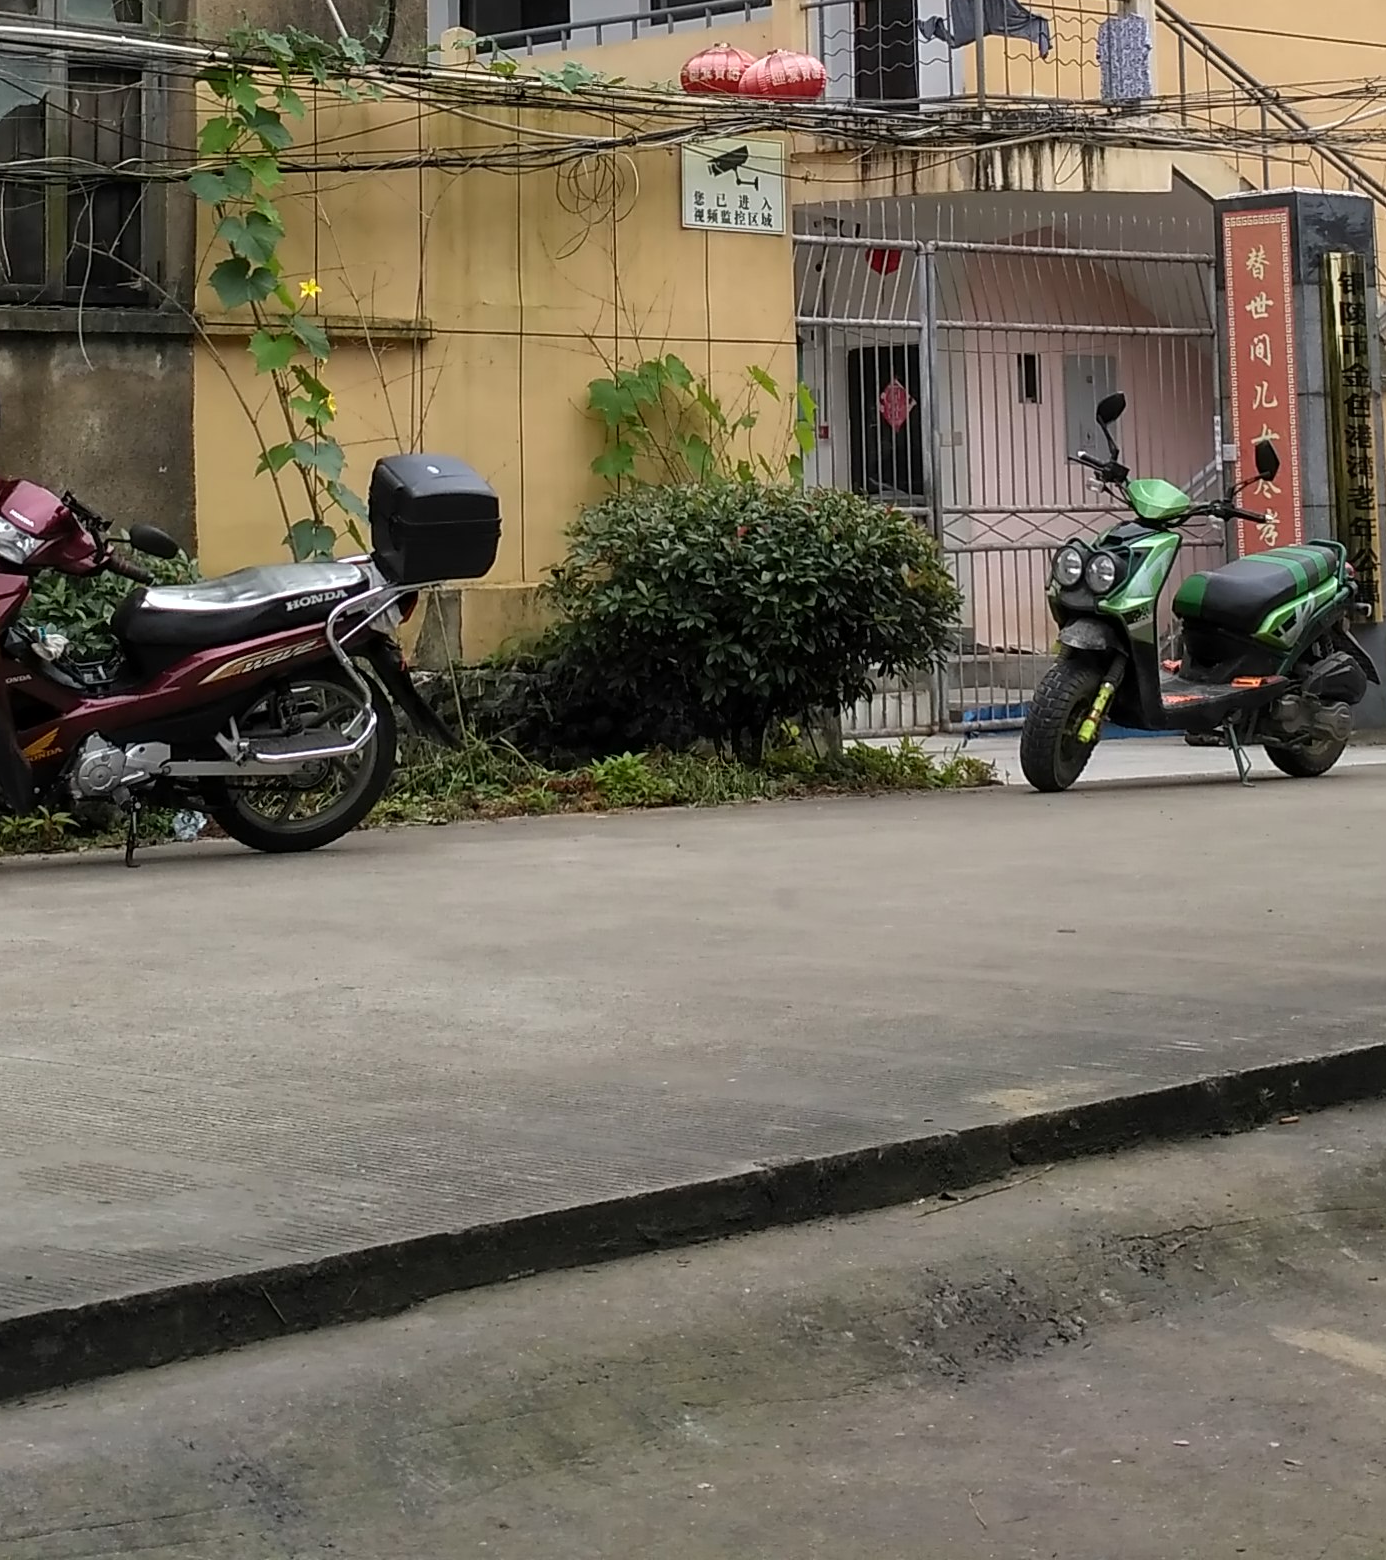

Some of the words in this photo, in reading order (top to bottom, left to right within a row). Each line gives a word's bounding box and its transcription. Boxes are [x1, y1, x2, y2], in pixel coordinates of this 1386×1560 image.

[693, 190, 773, 211] 您已进入
[693, 207, 773, 228] 视频监控区域
[9, 509, 35, 528] HONDA
[284, 589, 349, 612] HONDA
[5, 674, 32, 684] ONDA
[29, 747, 64, 762] ONDA
